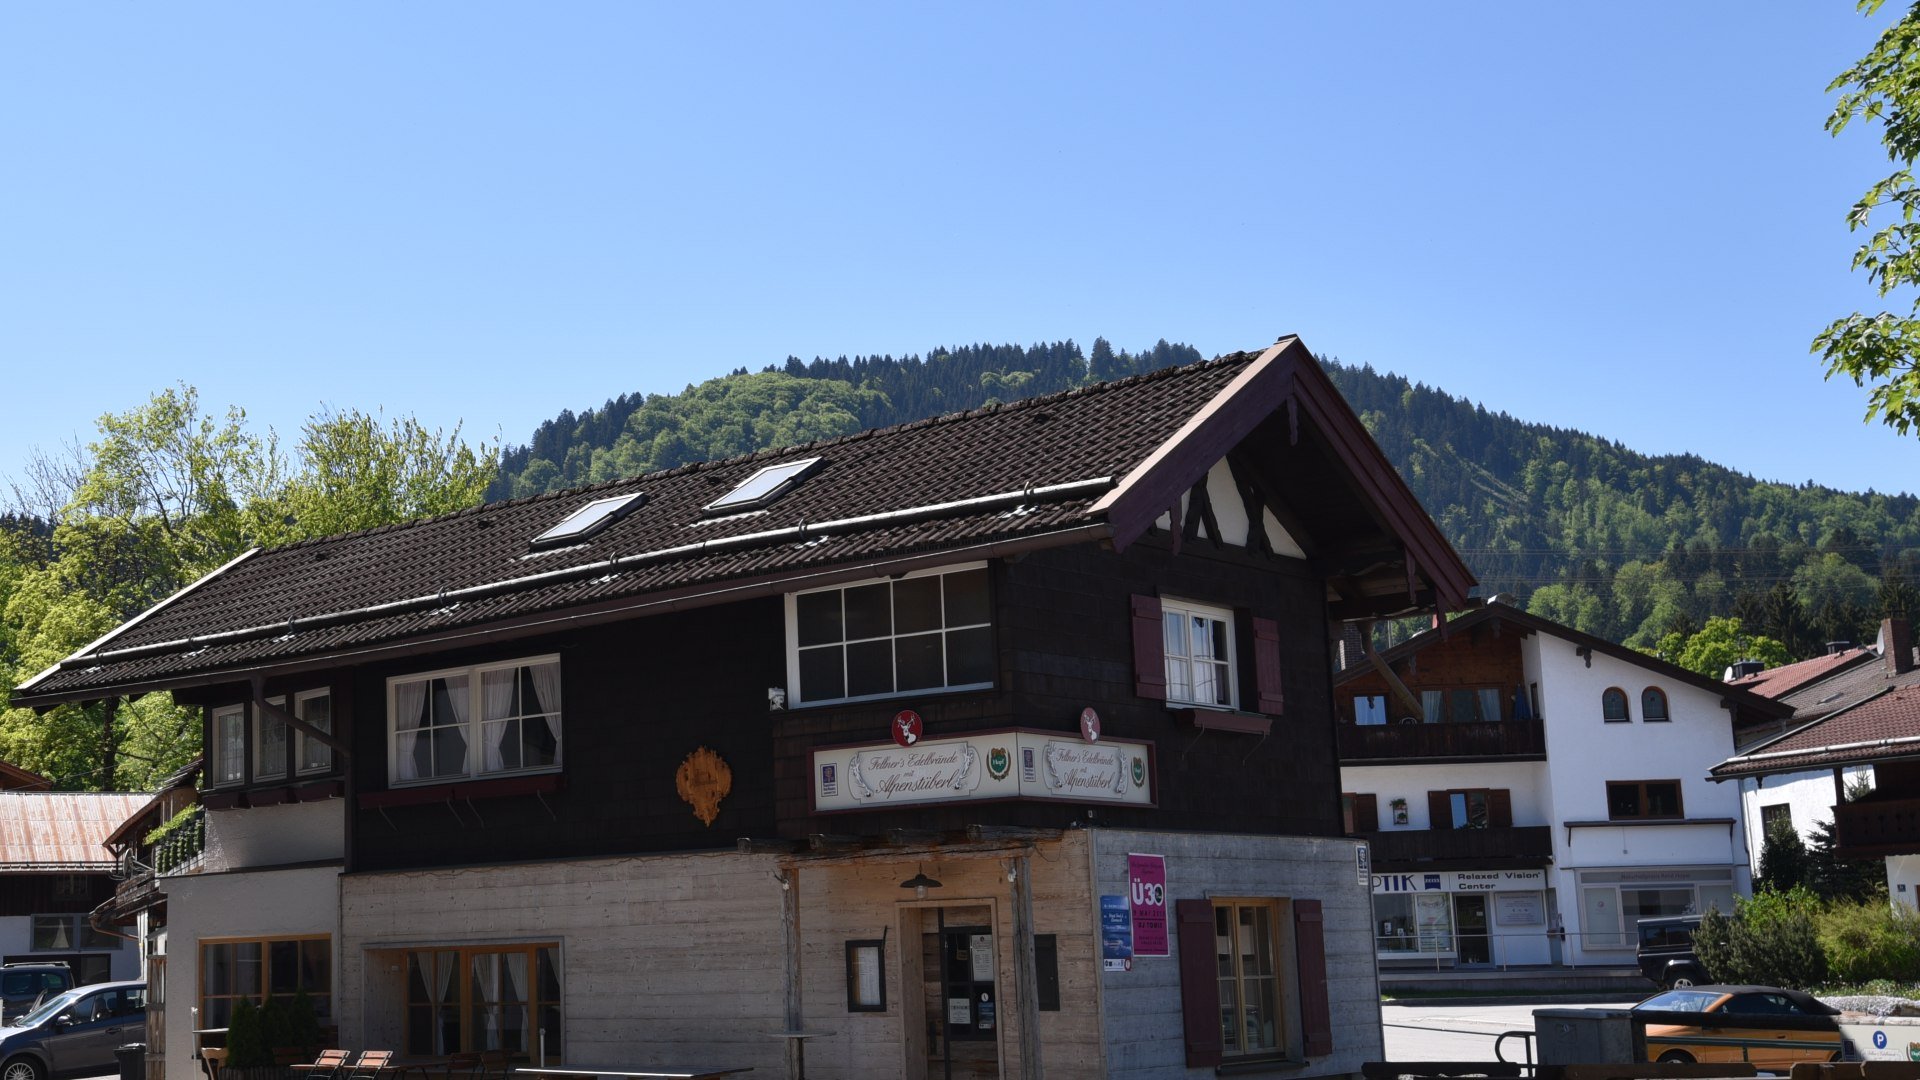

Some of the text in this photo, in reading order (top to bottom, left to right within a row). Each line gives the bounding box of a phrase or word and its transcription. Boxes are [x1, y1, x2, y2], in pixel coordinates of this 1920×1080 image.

[868, 751, 957, 771] Fellner's Edelbrände
[1056, 748, 1115, 766] Fellner's Edelbrände
[875, 769, 959, 799] Alpenstüberl
[1063, 768, 1116, 792] Alpenstüberl
[1457, 872, 1499, 880] Relaxed
[1131, 877, 1163, 906] Ü30
[1876, 1033, 1884, 1046] P
